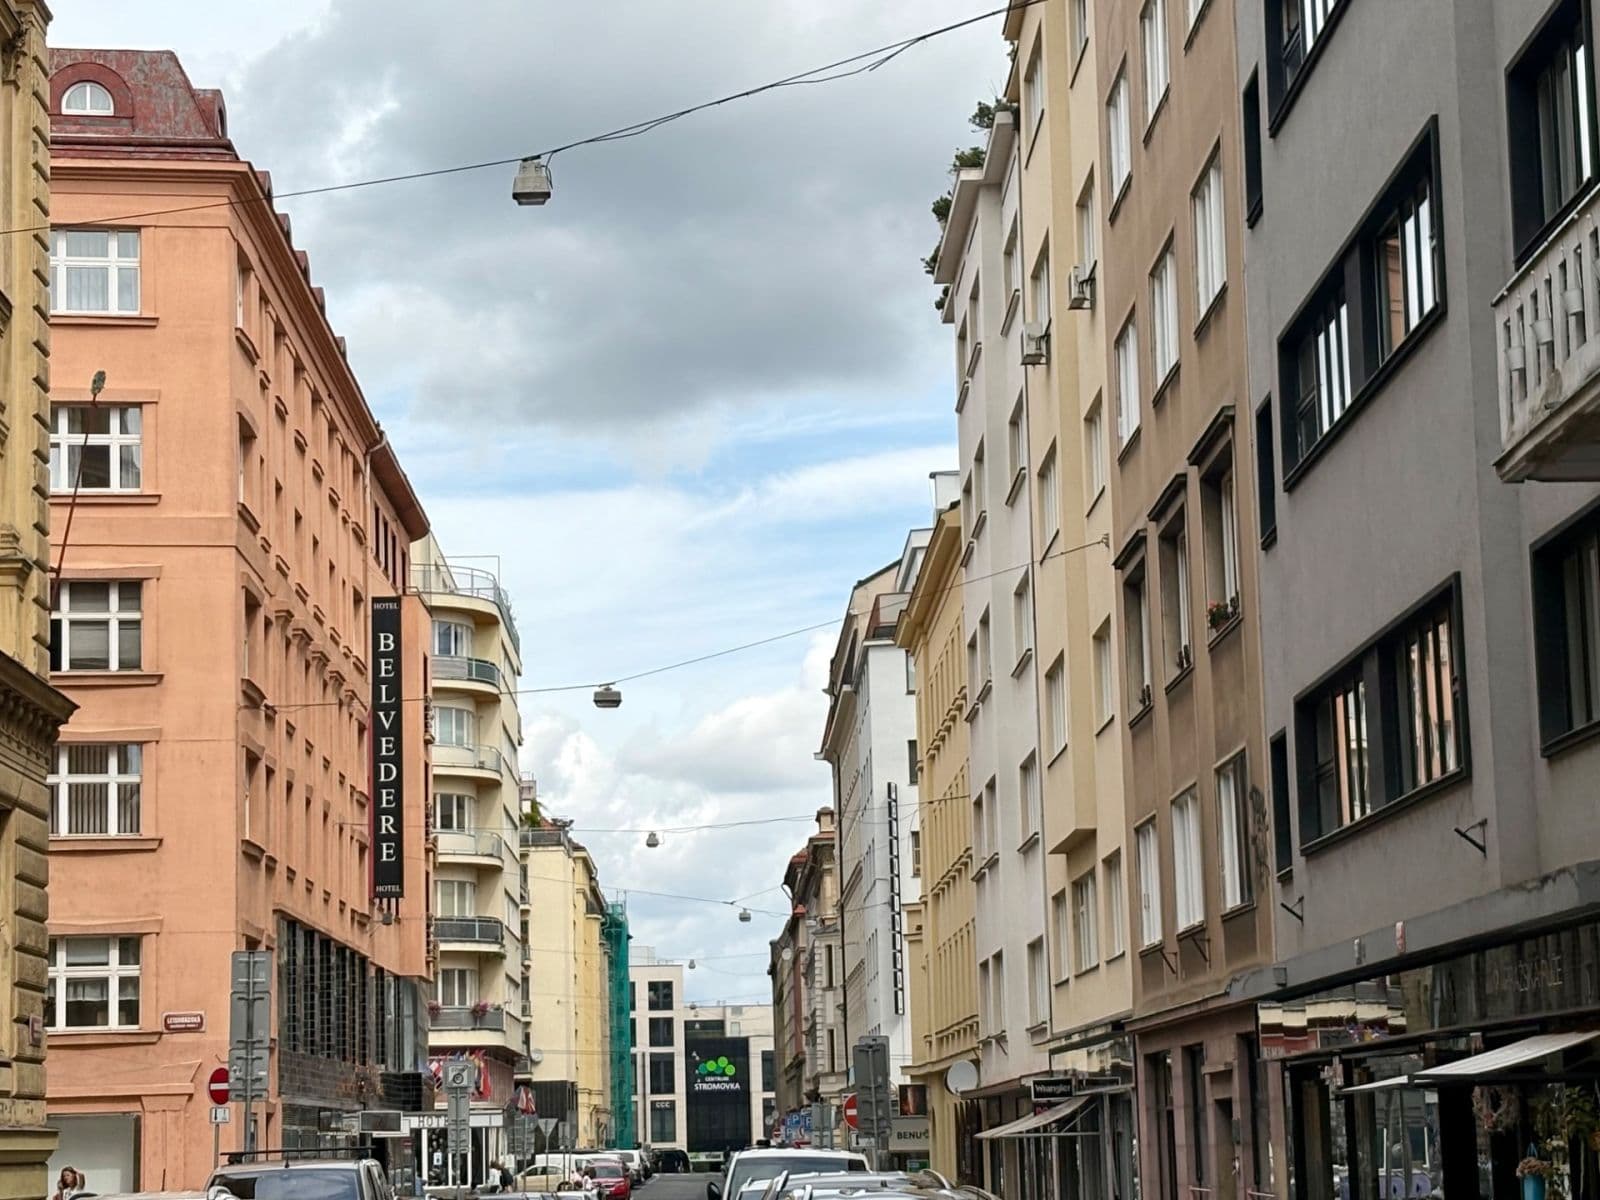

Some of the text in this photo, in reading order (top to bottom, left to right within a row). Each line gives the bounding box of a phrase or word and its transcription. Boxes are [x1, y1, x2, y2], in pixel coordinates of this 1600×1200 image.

[378, 633, 397, 861] BELVEDERE
[1035, 1084, 1070, 1094] Wrangler
[418, 1115, 448, 1128] HOTE
[897, 1131, 921, 1139] BENU
